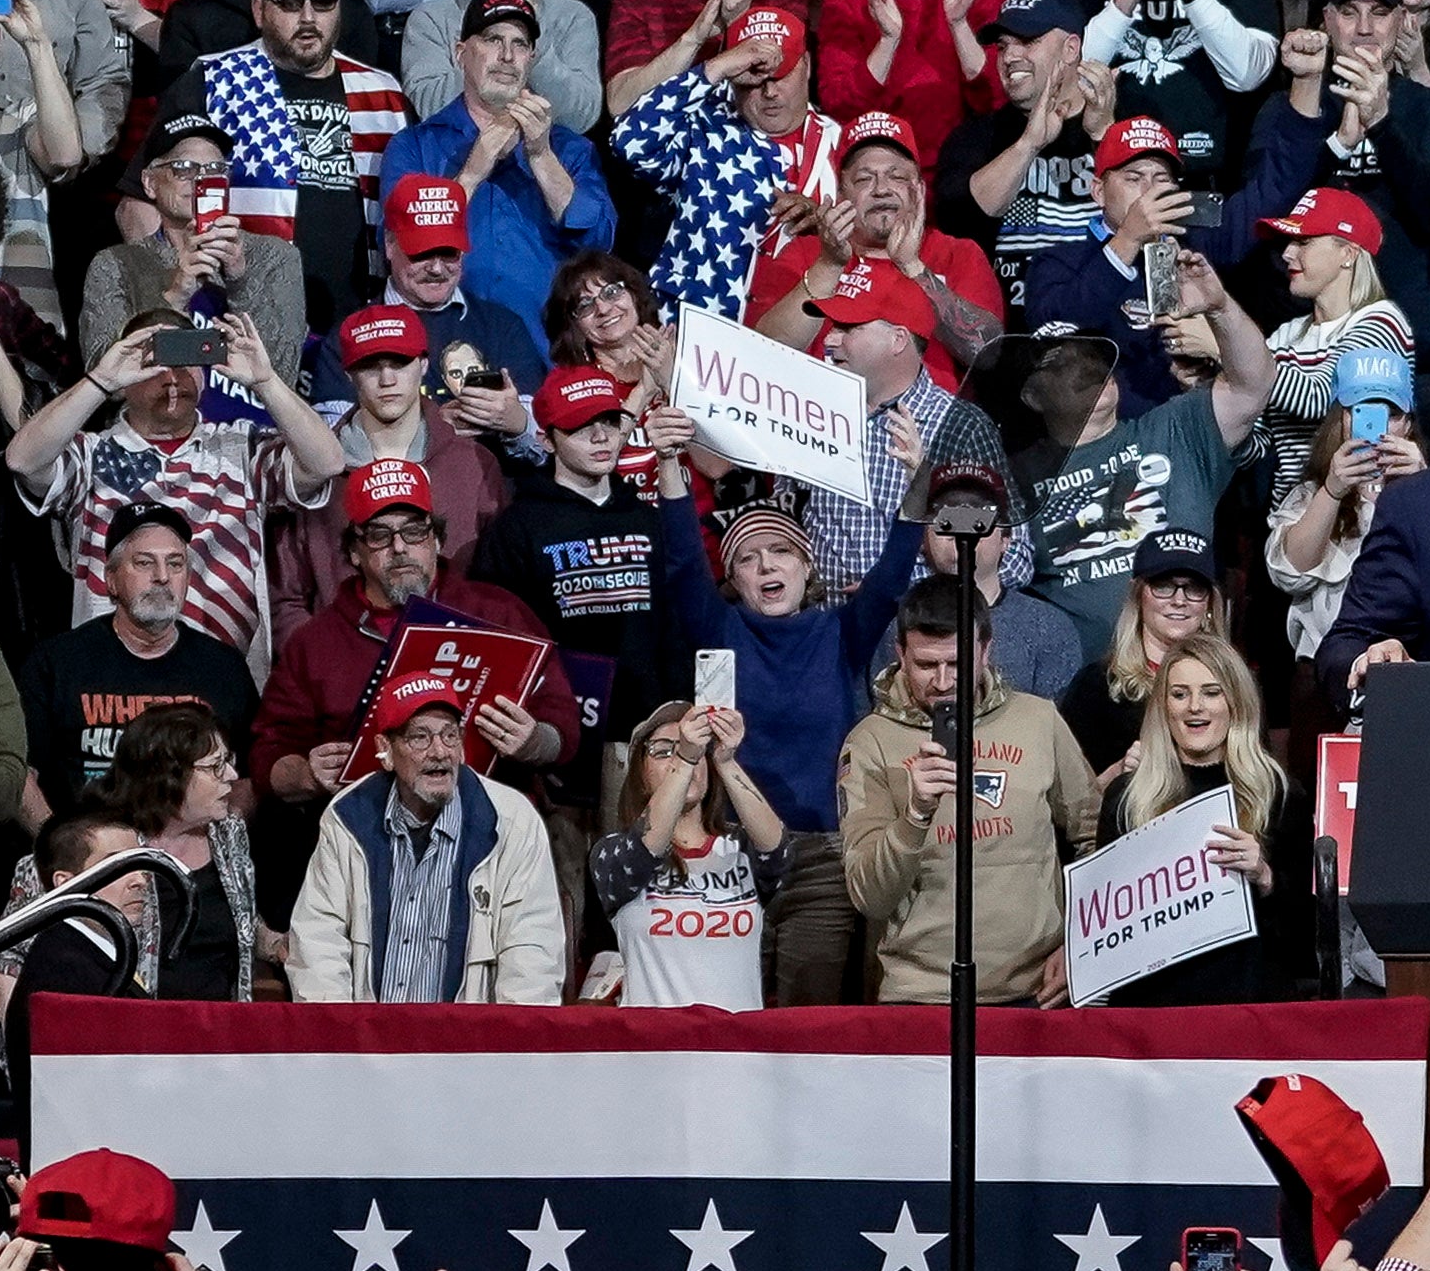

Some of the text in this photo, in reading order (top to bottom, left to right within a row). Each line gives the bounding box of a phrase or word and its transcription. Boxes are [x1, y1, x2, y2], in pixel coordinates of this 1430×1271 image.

[737, 21, 791, 42] AMERICA
[418, 187, 450, 200] KEEP
[406, 200, 460, 214] AMERICA
[414, 213, 455, 227] GREAT
[691, 343, 854, 450] Women
[707, 402, 841, 459] FOR TRUMP
[372, 461, 404, 477] KEEP
[362, 473, 418, 493] AMERICA
[1032, 466, 1095, 498] PROUD
[370, 486, 412, 501] GREAT
[543, 535, 651, 573] TRUMP
[552, 574, 593, 598] 2020
[392, 679, 447, 701] TRUMP
[648, 907, 755, 940] 2020
[1093, 889, 1216, 958] FOR TRUMP
[1147, 958, 1168, 971] 2020
